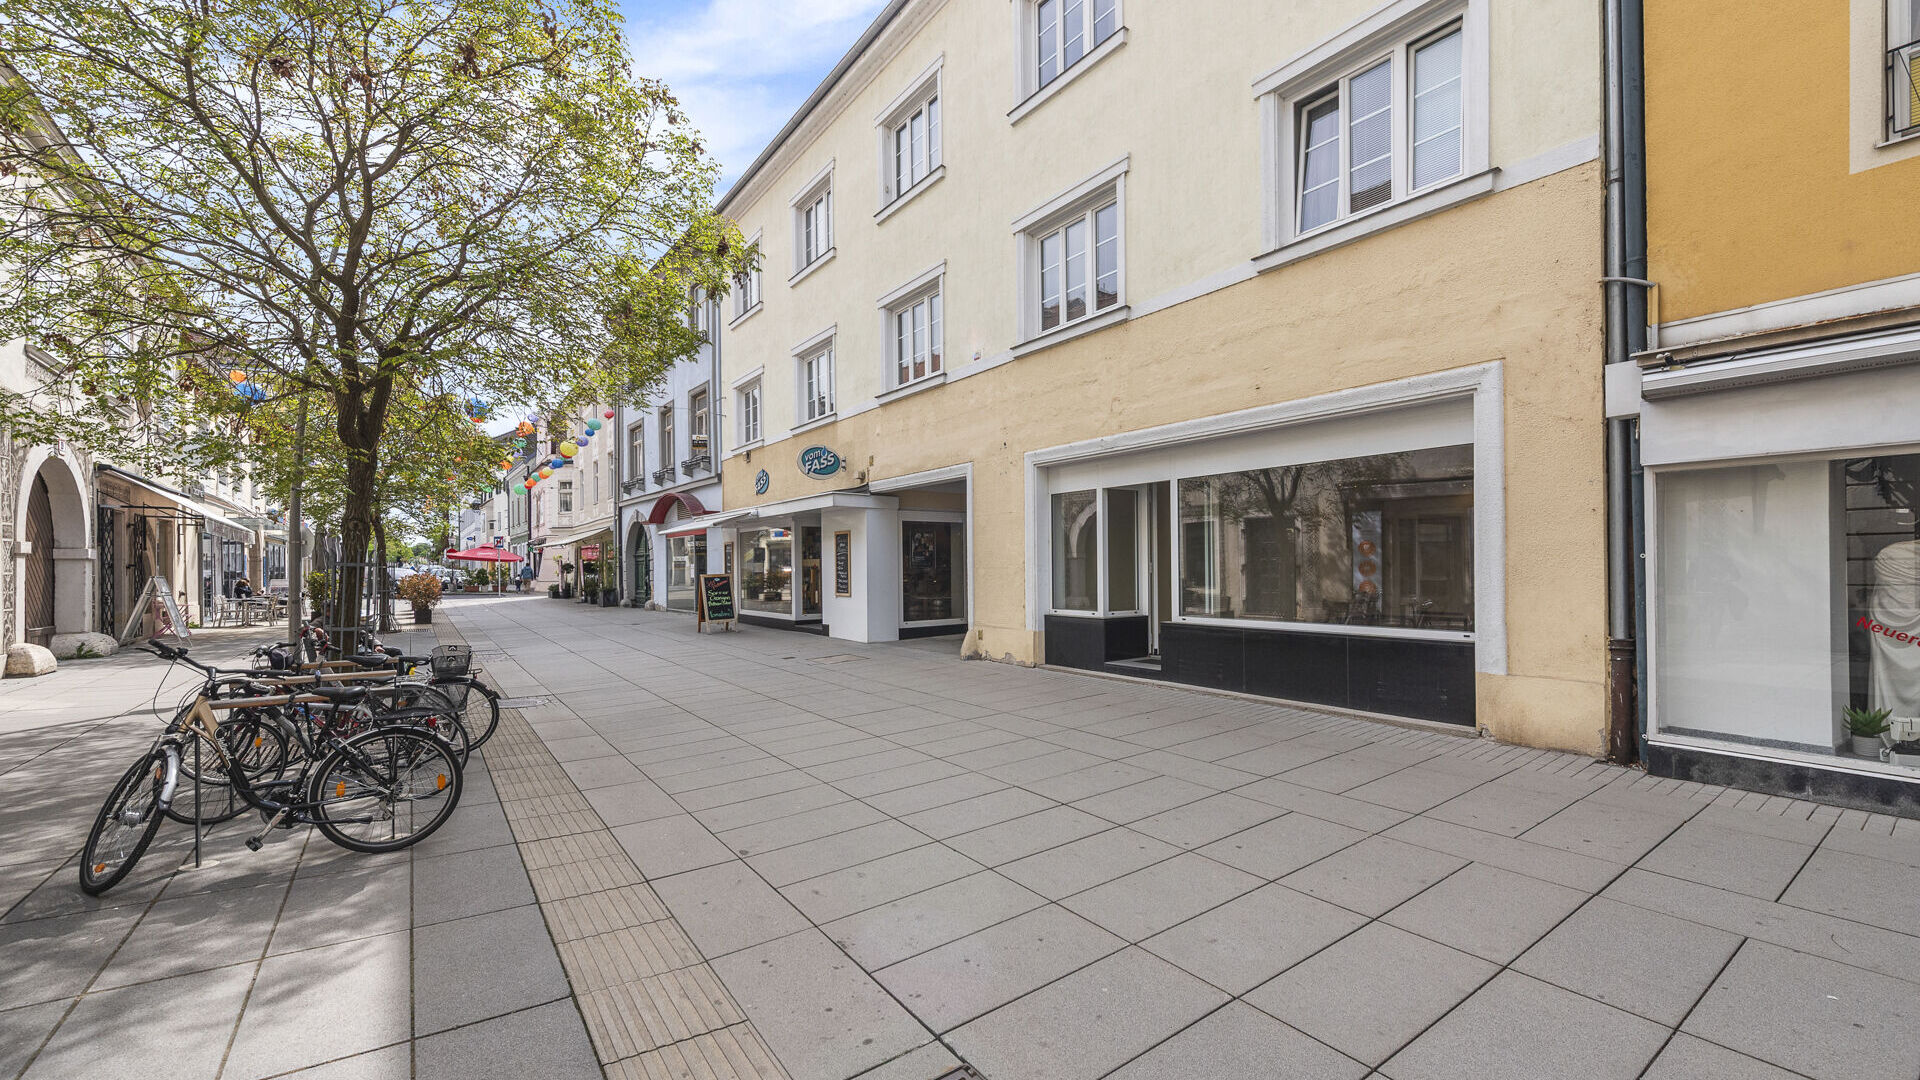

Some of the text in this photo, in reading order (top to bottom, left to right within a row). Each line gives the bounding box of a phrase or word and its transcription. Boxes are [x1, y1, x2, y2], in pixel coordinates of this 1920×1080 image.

[804, 453, 835, 474] FASS
[805, 450, 821, 461] vom
[1856, 616, 1920, 647] Neuer
